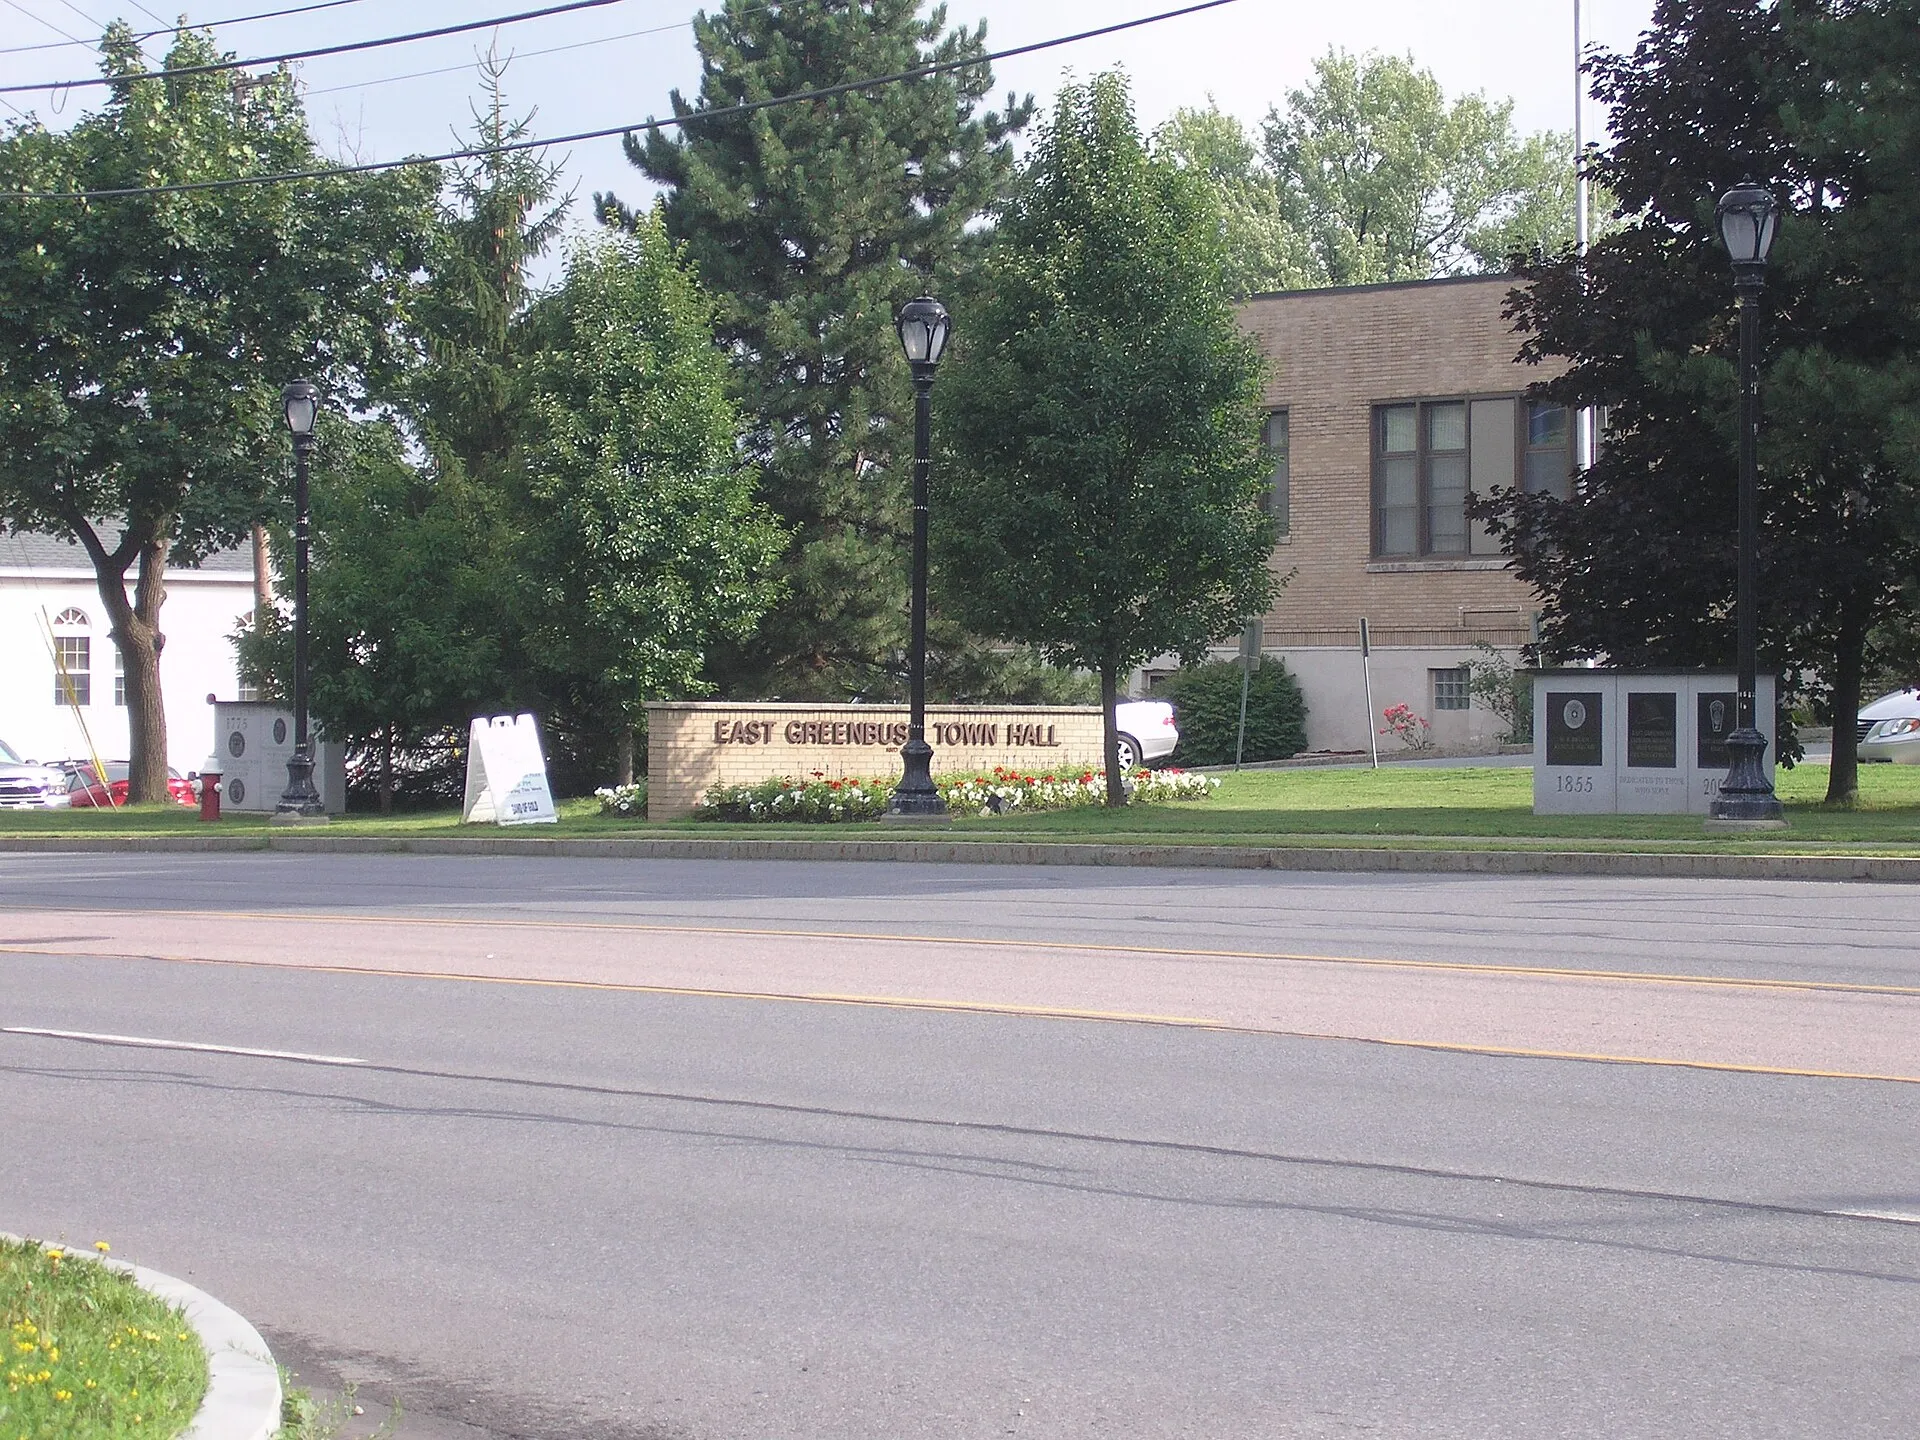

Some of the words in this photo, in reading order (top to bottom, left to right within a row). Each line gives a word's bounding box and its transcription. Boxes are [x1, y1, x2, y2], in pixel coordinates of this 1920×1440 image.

[226, 717, 248, 730] 1775
[714, 720, 777, 744] EAST
[785, 720, 911, 746] GREENBUS
[933, 722, 997, 747] TOWN
[1006, 723, 1062, 747] HALL
[1556, 775, 1593, 793] 1855
[1703, 778, 1723, 796] 200
